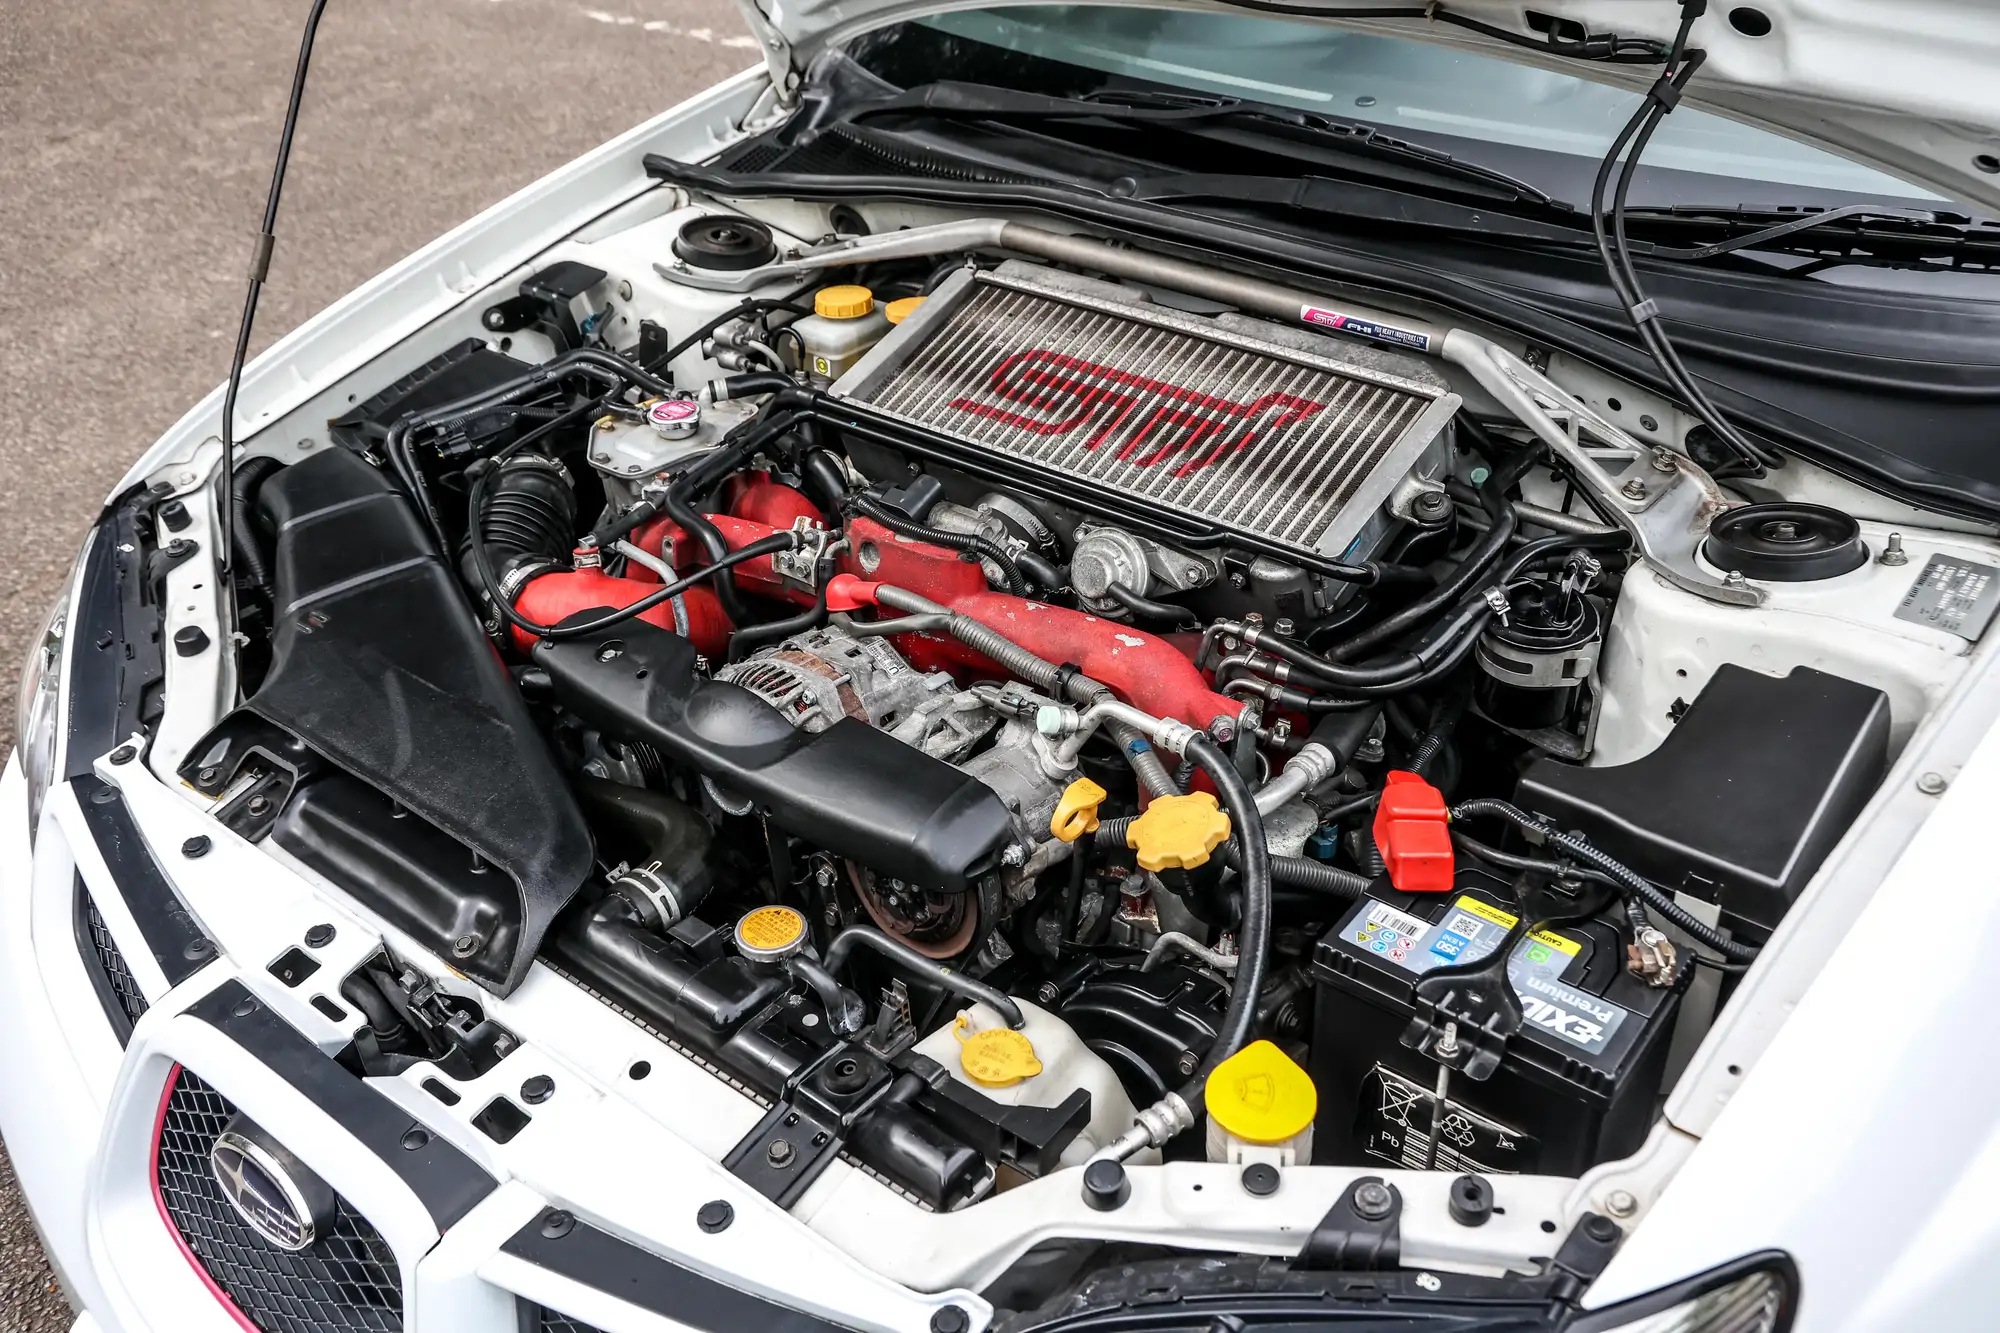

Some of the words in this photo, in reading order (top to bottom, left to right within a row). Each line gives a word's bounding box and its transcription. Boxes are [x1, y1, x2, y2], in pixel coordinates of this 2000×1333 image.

[1382, 327, 1395, 337] HEAVY
[1394, 329, 1417, 342] INDUSTRIES
[1435, 940, 1460, 956] 350
[1526, 978, 1615, 1024] Premium
[1515, 989, 1604, 1044] EXID
[1381, 1130, 1400, 1148] Pb
